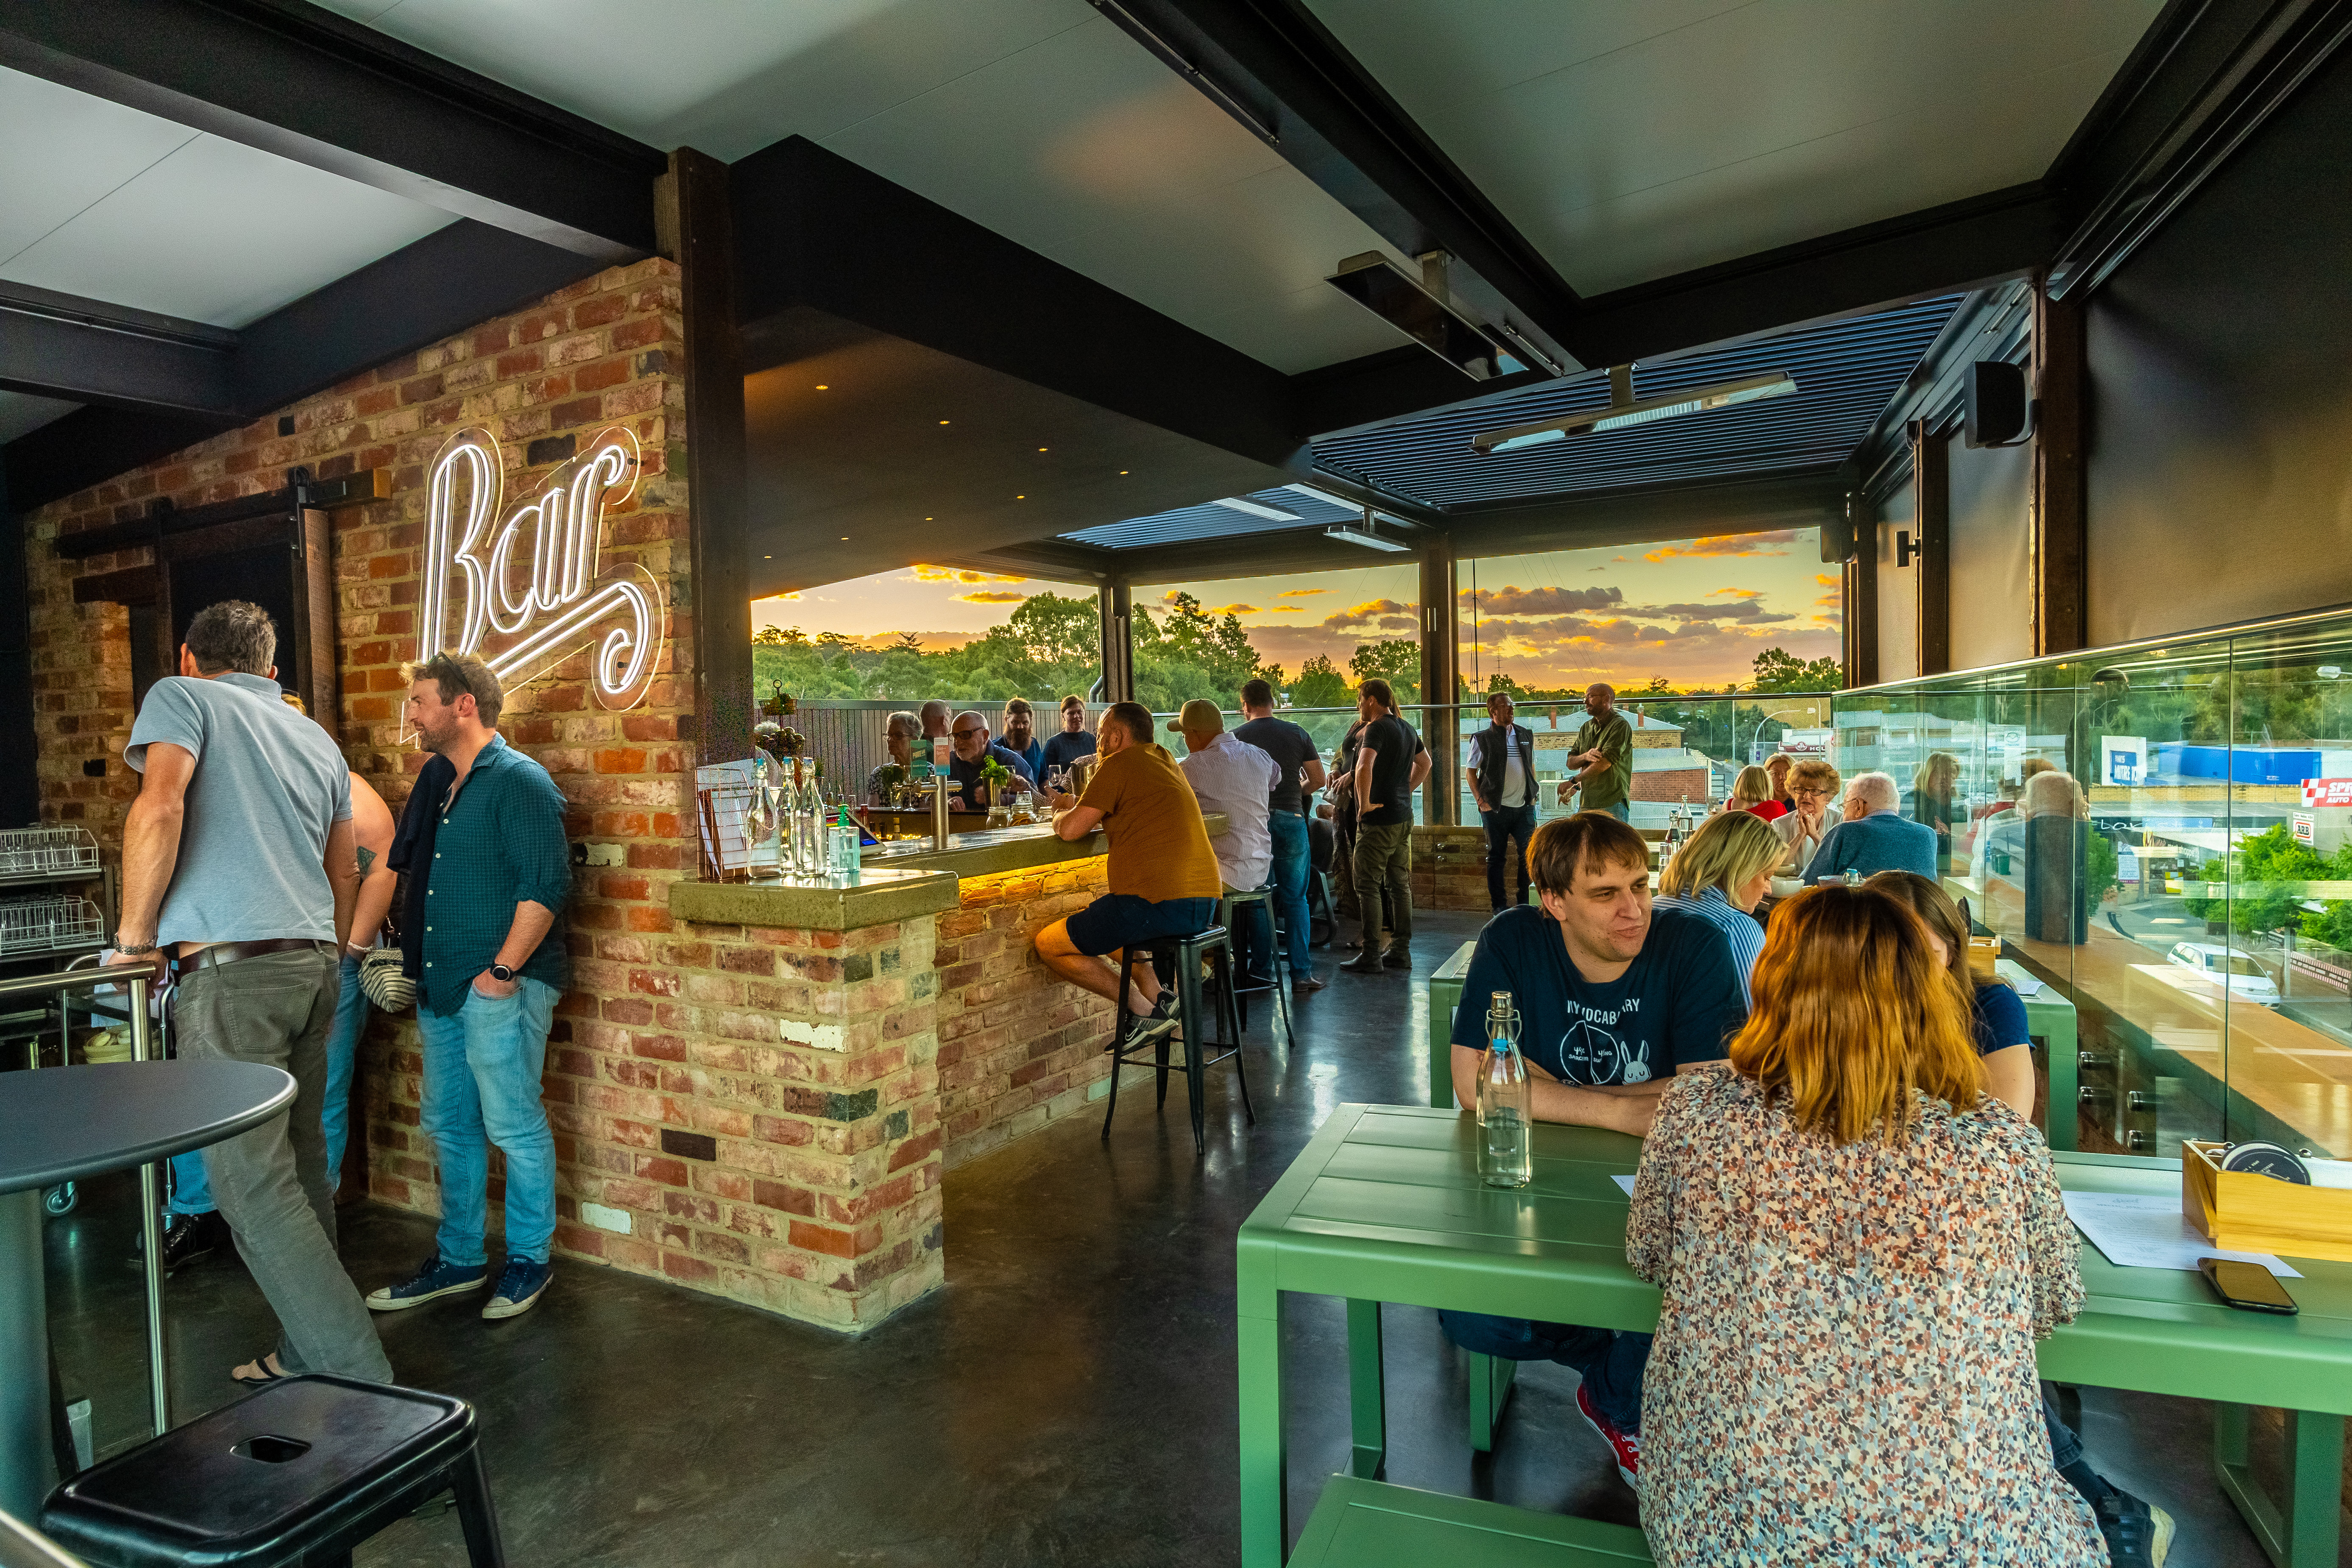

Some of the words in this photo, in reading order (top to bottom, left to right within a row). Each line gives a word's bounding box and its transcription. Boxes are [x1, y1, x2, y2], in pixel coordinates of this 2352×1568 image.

[422, 444, 655, 694] Bar
[2114, 765, 2130, 781] MITRE
[2297, 825, 2309, 835] ARB
[1582, 999, 1640, 1025] OCABARY
